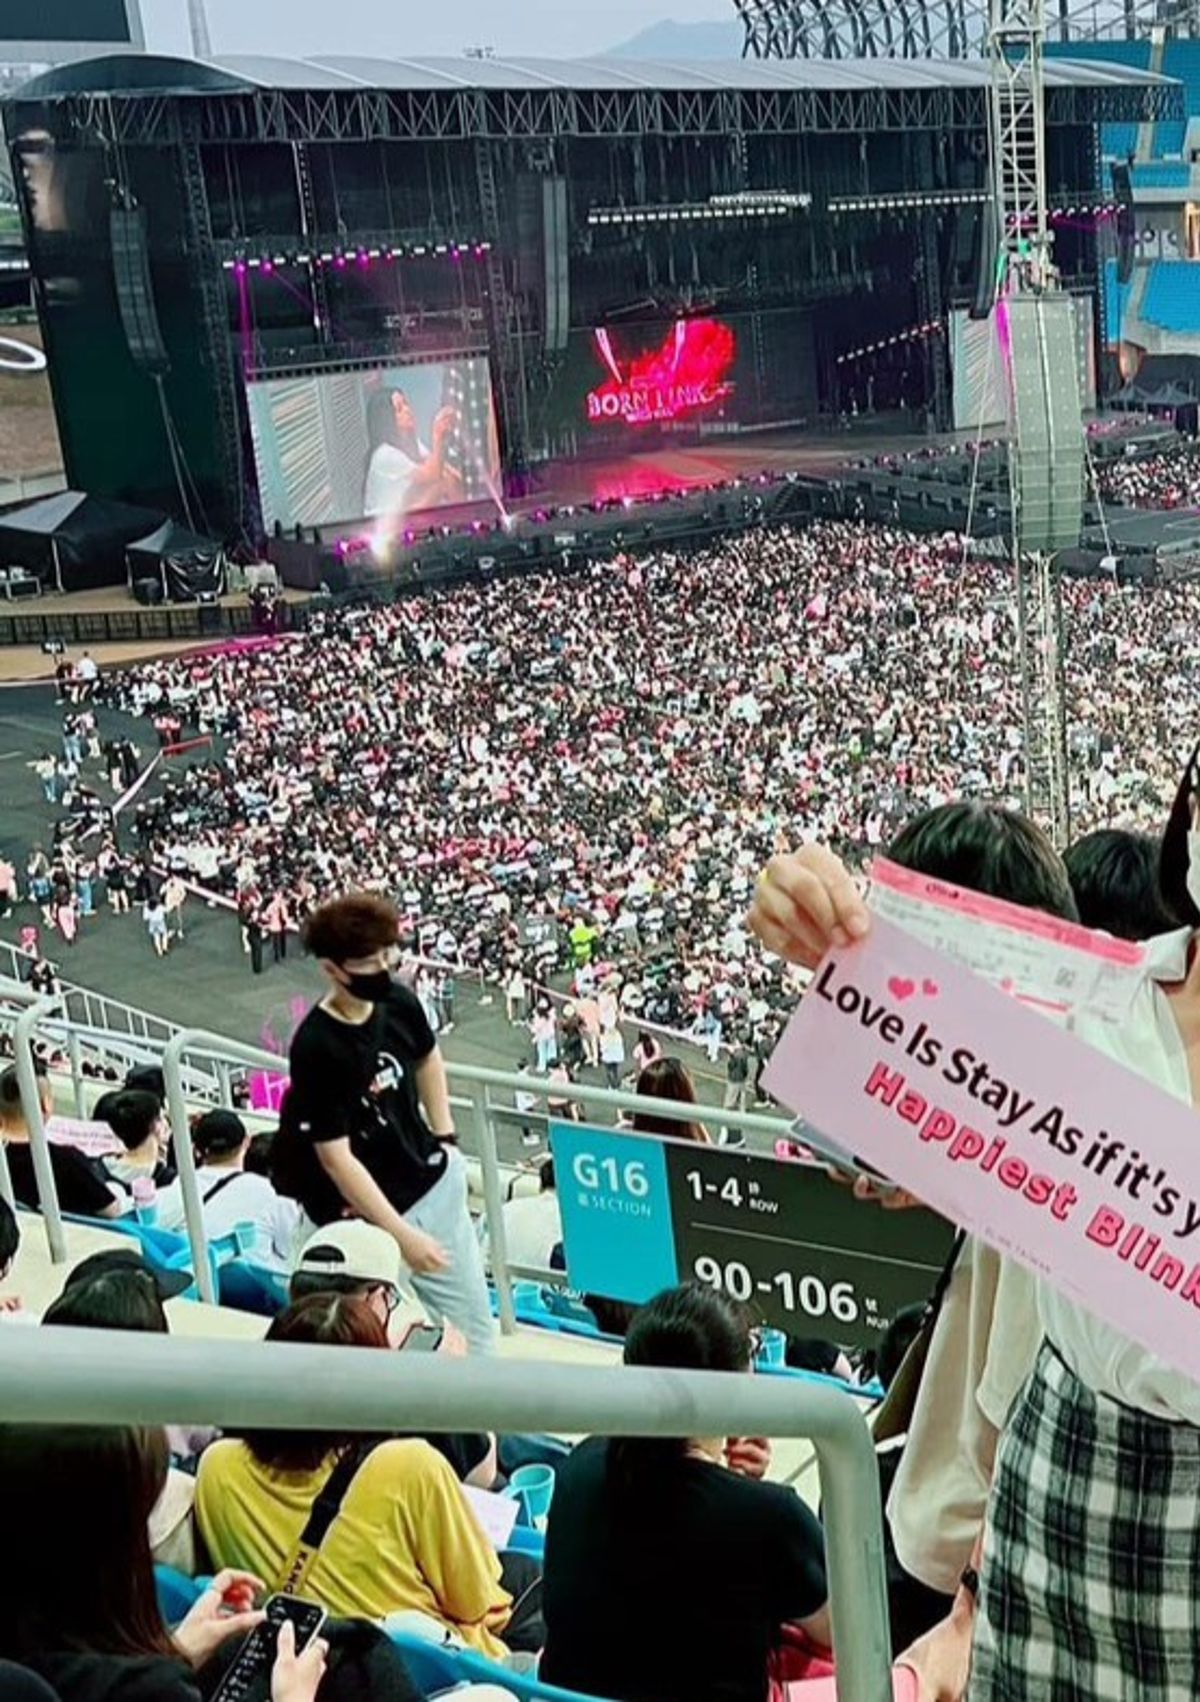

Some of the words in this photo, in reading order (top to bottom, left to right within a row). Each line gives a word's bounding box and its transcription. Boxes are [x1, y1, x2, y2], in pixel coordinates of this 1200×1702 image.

[815, 961, 904, 1043] Love
[905, 1023, 942, 1066] Is
[942, 1048, 1034, 1126] Stay
[1030, 1106, 1083, 1155] As
[1082, 1131, 1125, 1175] if
[1114, 1151, 1181, 1216] it's
[864, 1060, 1077, 1221] Happiest
[573, 1153, 649, 1196] G16
[686, 1171, 743, 1207] 1-4
[591, 1195, 651, 1218] SECTION
[749, 1198, 779, 1214] ROW
[694, 1256, 858, 1322] 90-106
